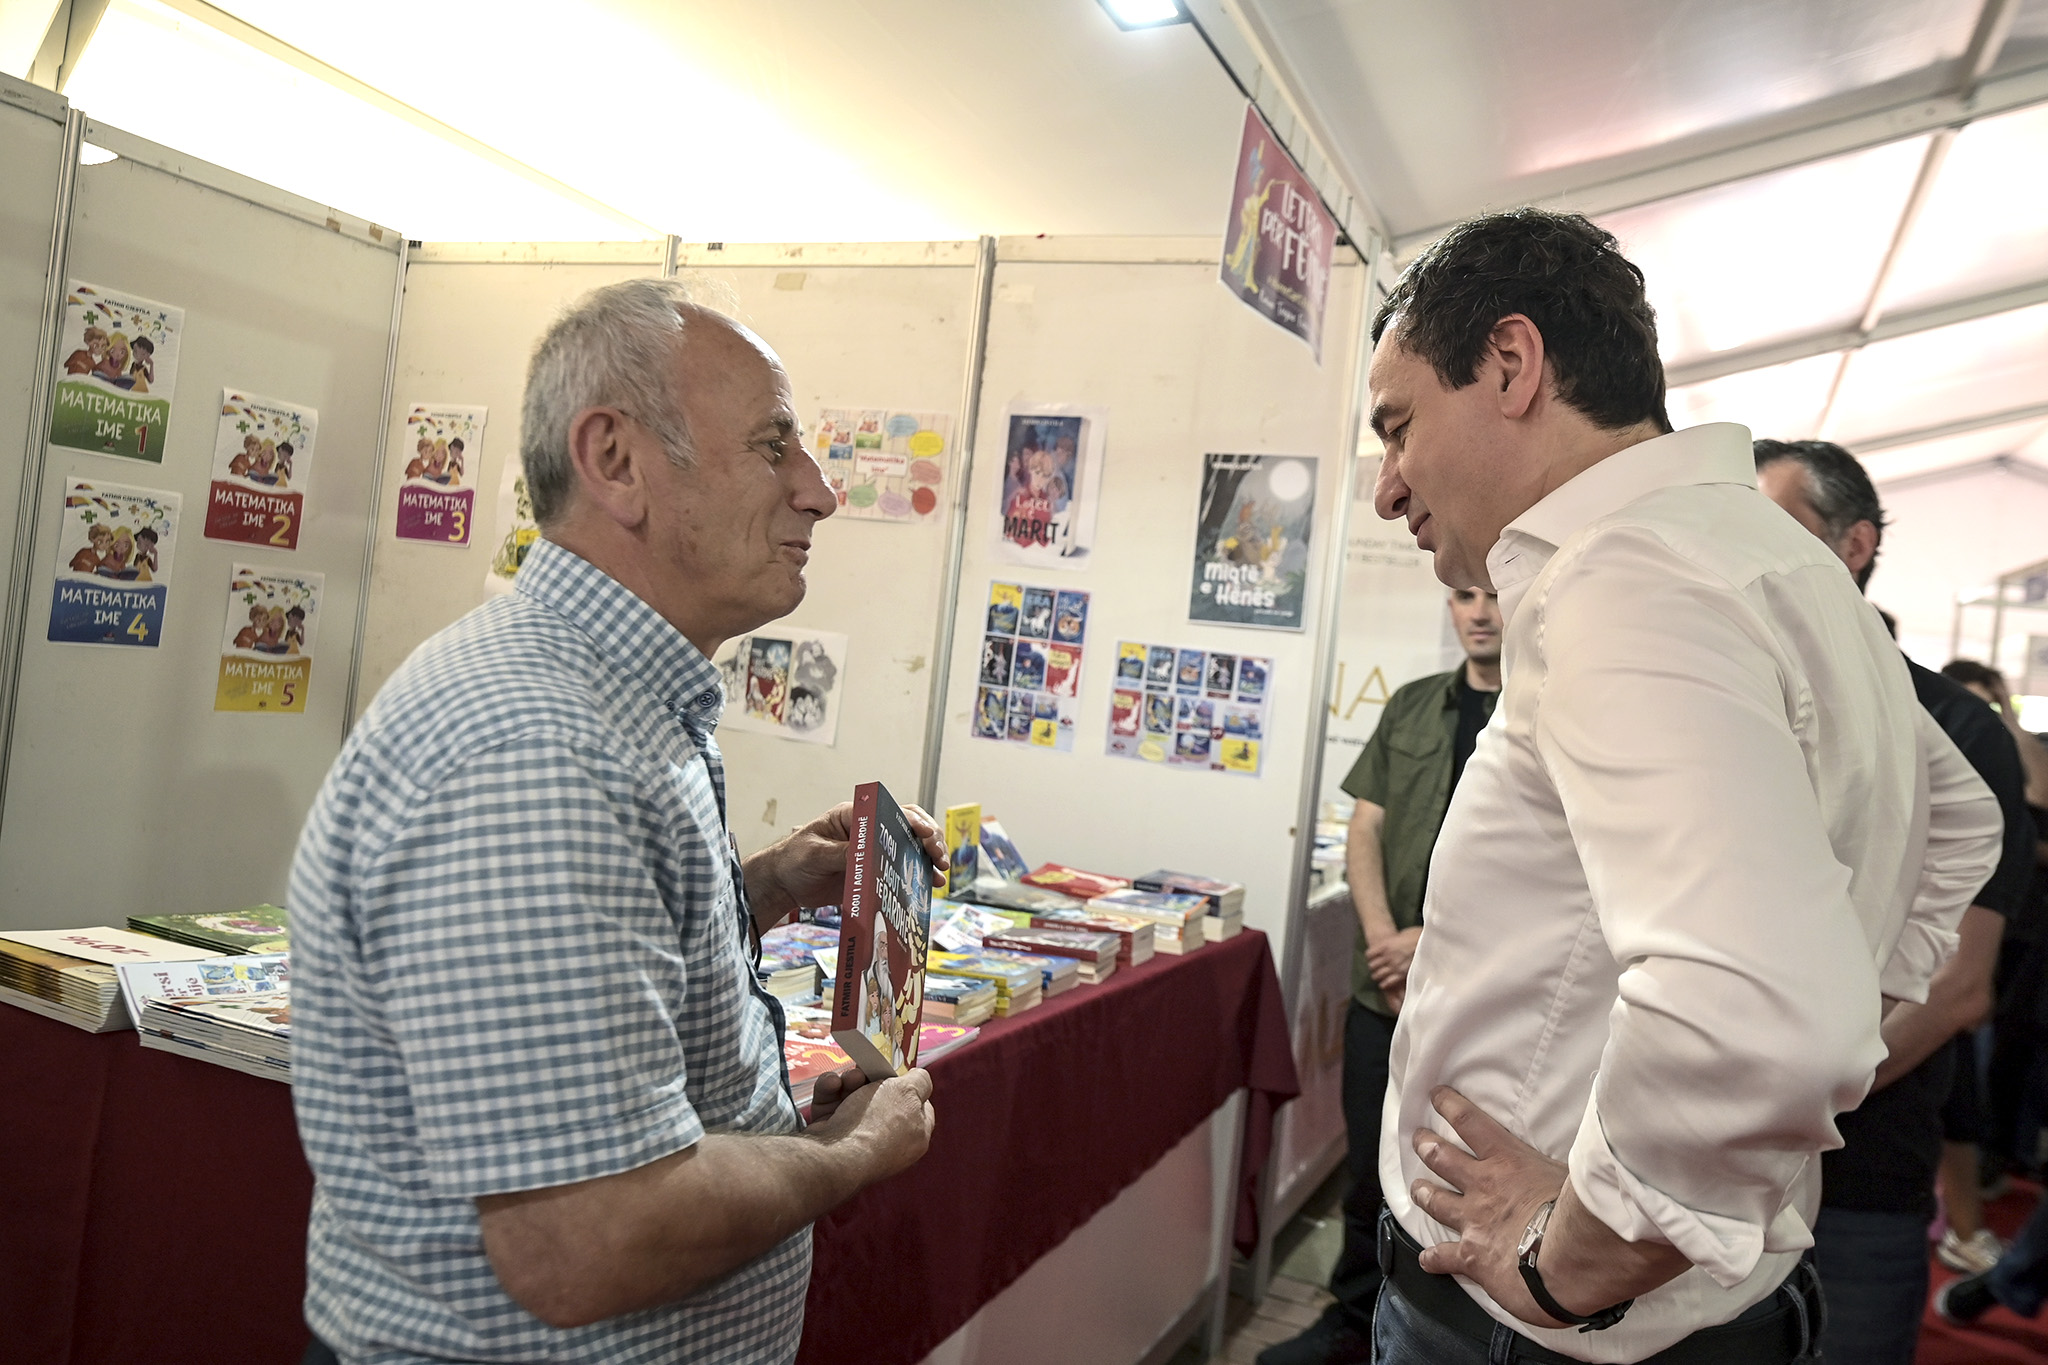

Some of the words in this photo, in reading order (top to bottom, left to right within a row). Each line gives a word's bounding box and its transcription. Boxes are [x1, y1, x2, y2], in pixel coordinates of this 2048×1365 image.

[61, 388, 161, 426] MATEMATIKA
[95, 419, 125, 440] IME
[135, 424, 148, 453] 1
[214, 488, 295, 516] MATEMATIKA
[403, 493, 467, 513] MATEMATIKA
[242, 511, 266, 528] IME
[269, 514, 291, 545] 2
[424, 511, 443, 526] IME
[448, 511, 465, 541] 3
[60, 587, 157, 611] MATEMATIKA
[94, 610, 122, 626] IME
[127, 613, 149, 642] 4
[225, 662, 303, 680] MATEMATIKA
[251, 681, 275, 695] IME
[280, 683, 296, 706] 5
[857, 815, 868, 850] BARDHË
[880, 822, 897, 862] ZOGU
[855, 851, 865, 862] TË
[853, 864, 864, 886] AGUT
[876, 876, 883, 899] TË
[880, 854, 884, 872] I
[883, 859, 901, 898] AGUT
[851, 894, 861, 918] ZOGU
[845, 936, 856, 979] GJESTILA
[841, 981, 852, 1017] FATMIR
